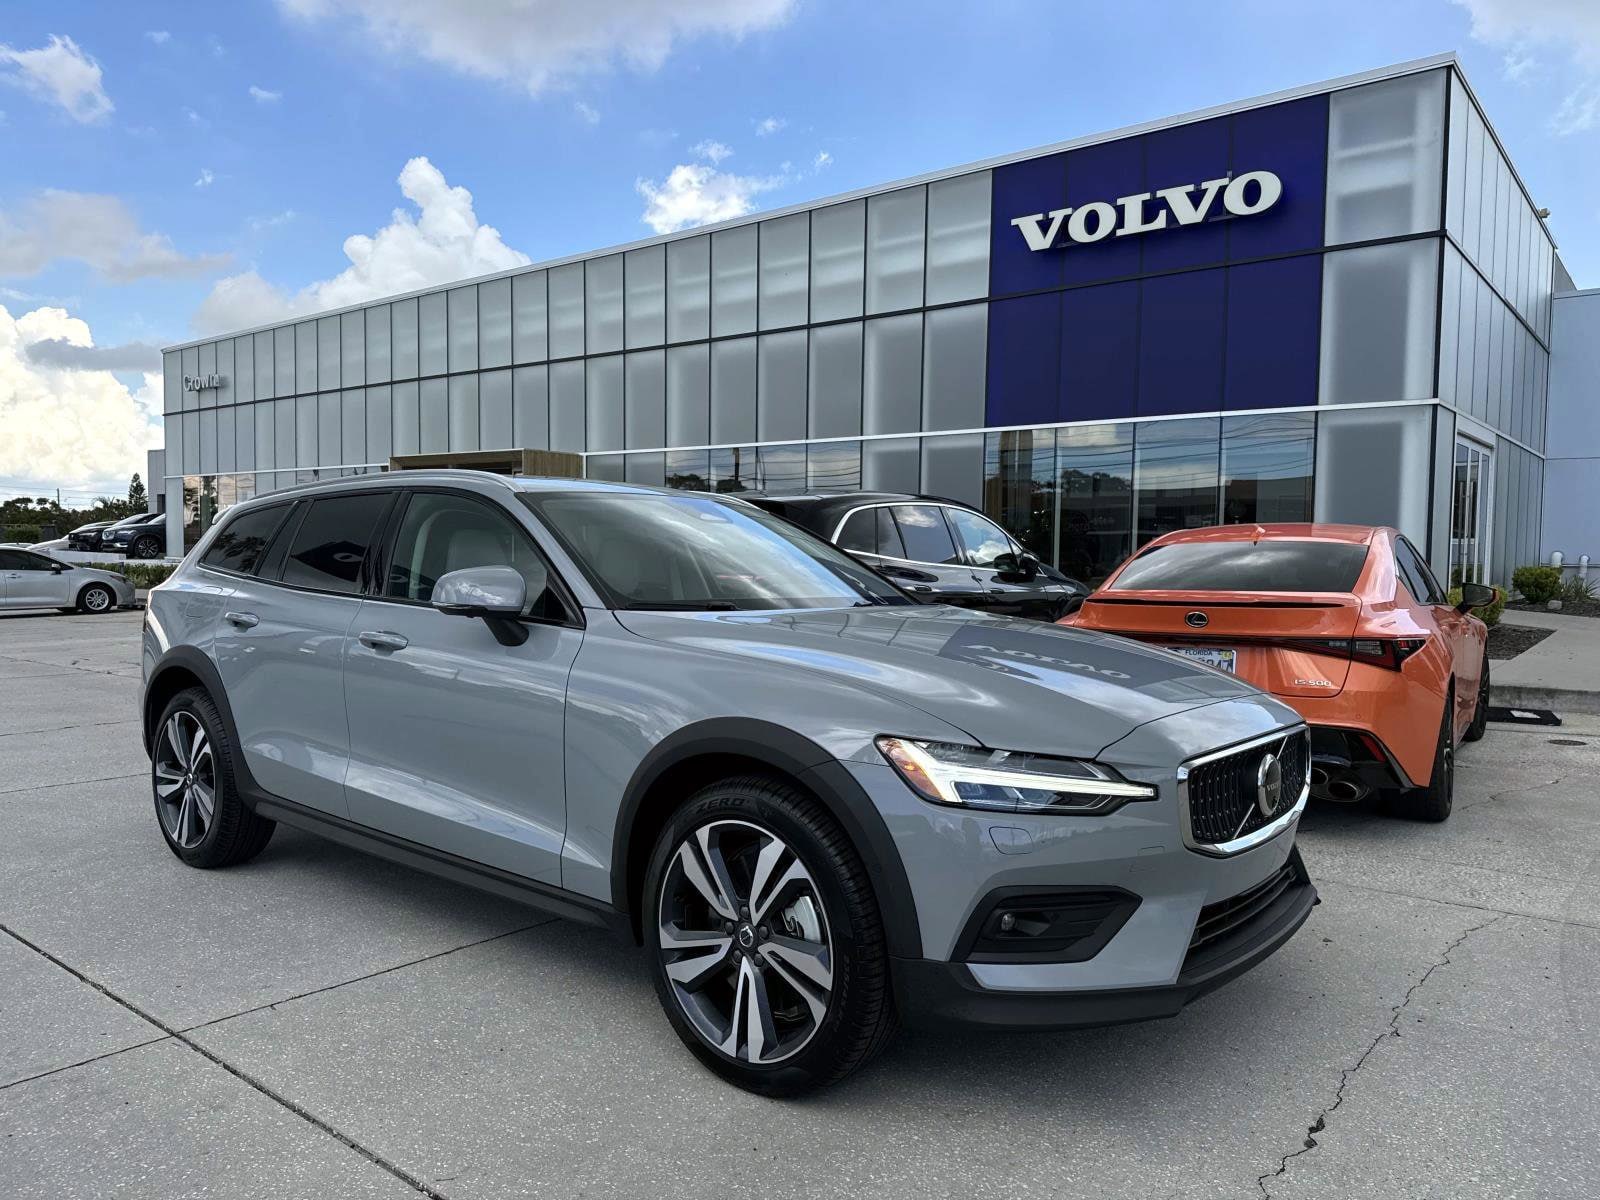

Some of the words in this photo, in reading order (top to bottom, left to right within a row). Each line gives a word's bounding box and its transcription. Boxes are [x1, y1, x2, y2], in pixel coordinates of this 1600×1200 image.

[1010, 170, 1282, 251] VOLVO
[183, 373, 220, 391] Crown
[1308, 679, 1332, 687] 500
[696, 797, 746, 813] ZERO
